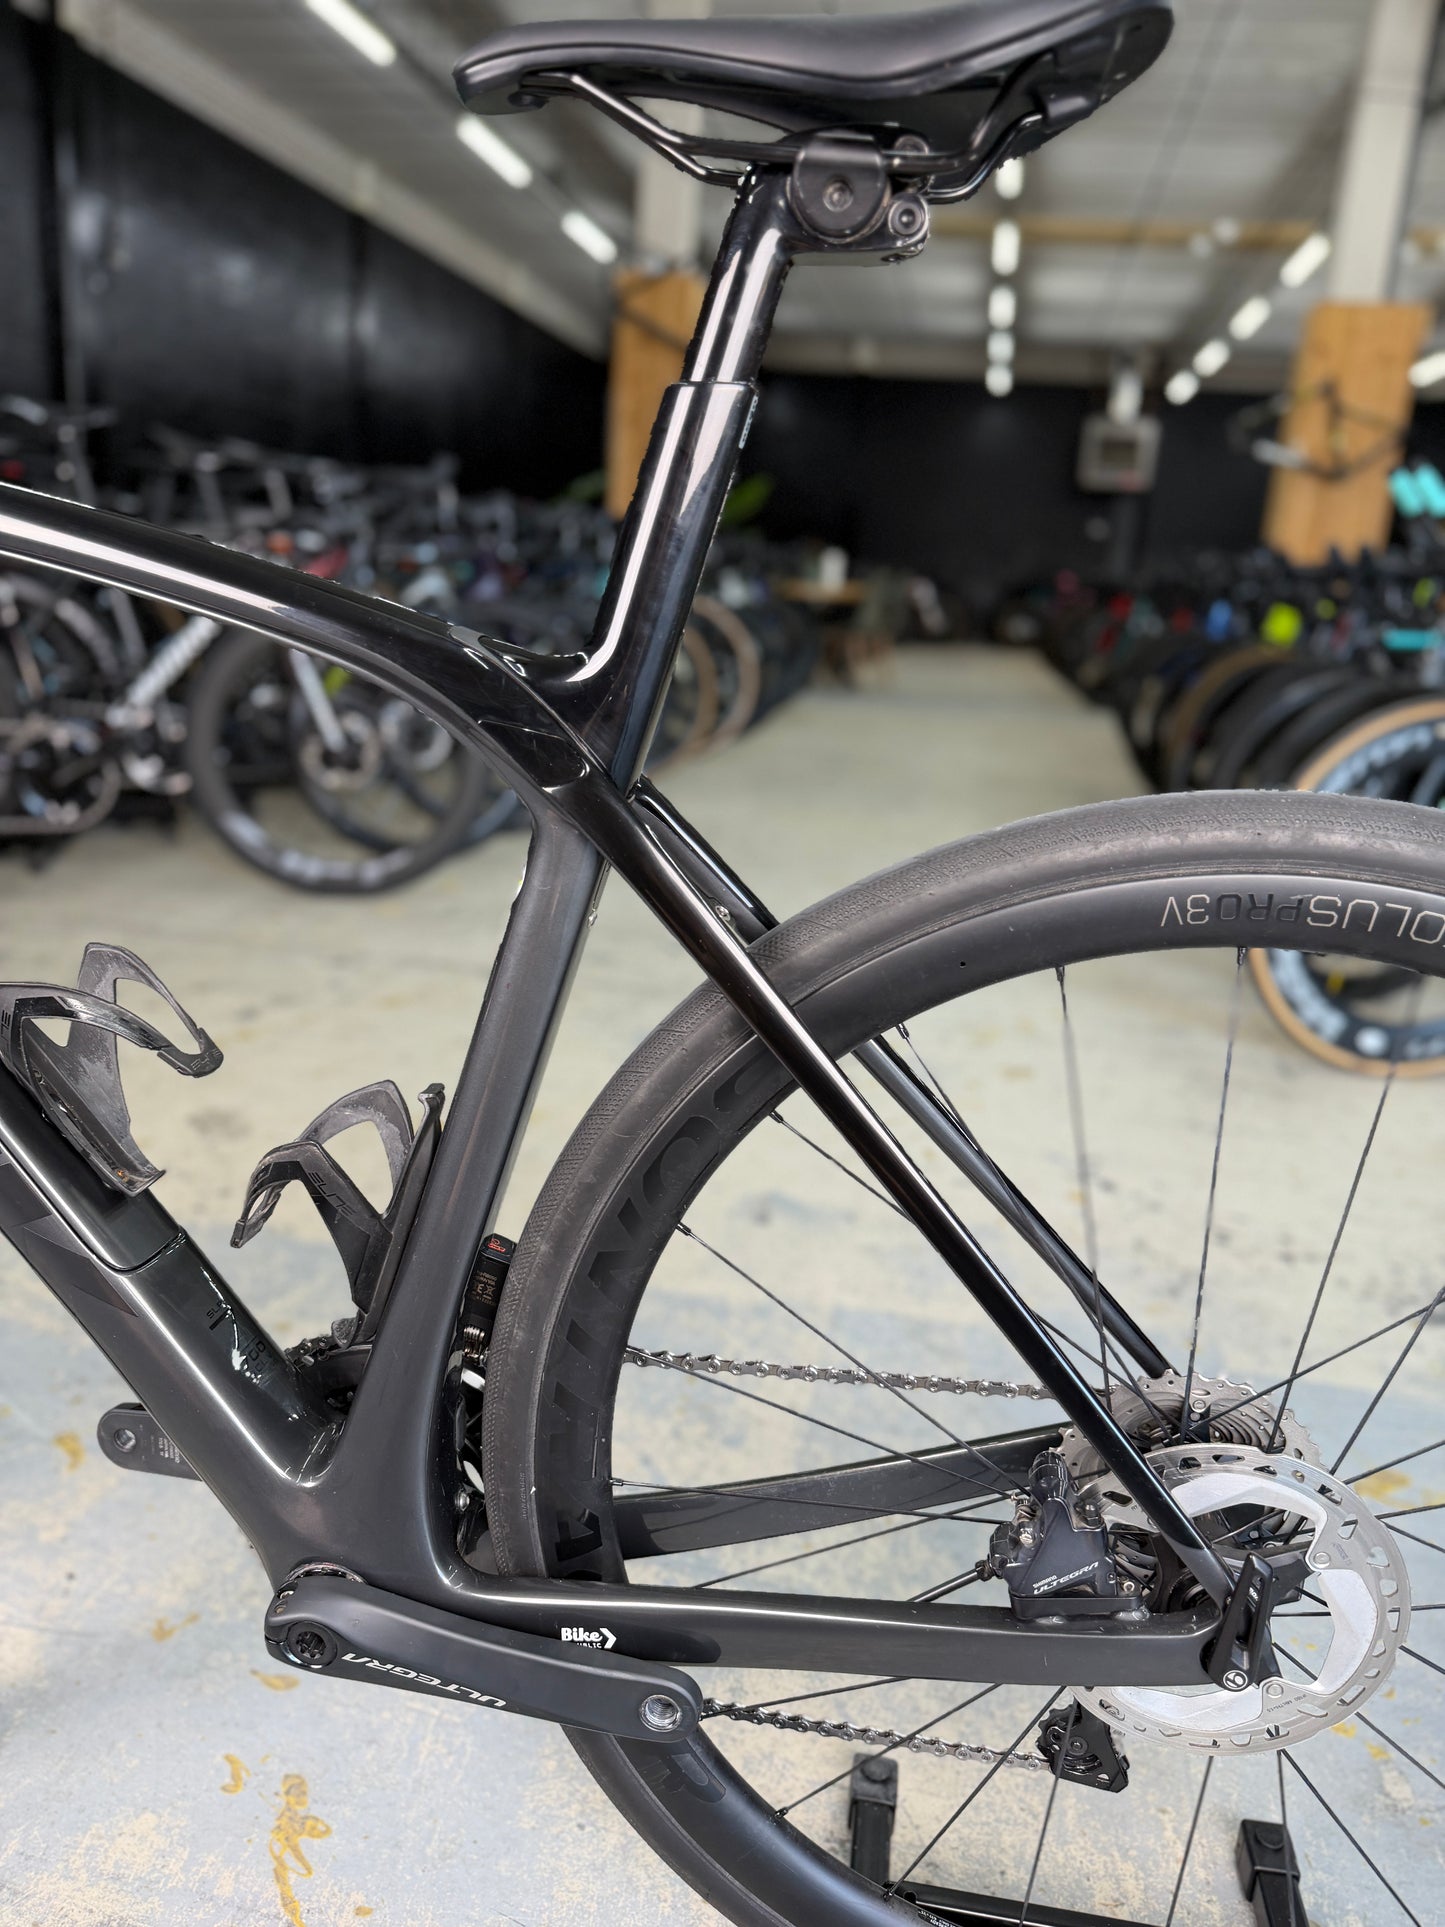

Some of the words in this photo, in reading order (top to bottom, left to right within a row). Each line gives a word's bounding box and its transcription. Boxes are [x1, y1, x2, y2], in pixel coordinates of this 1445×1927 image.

[1306, 894, 1445, 946] OLUS
[1033, 1561, 1099, 1595] ULTEGRA
[561, 1627, 603, 1642] Bike
[341, 1652, 507, 1707] ULTEGRA
